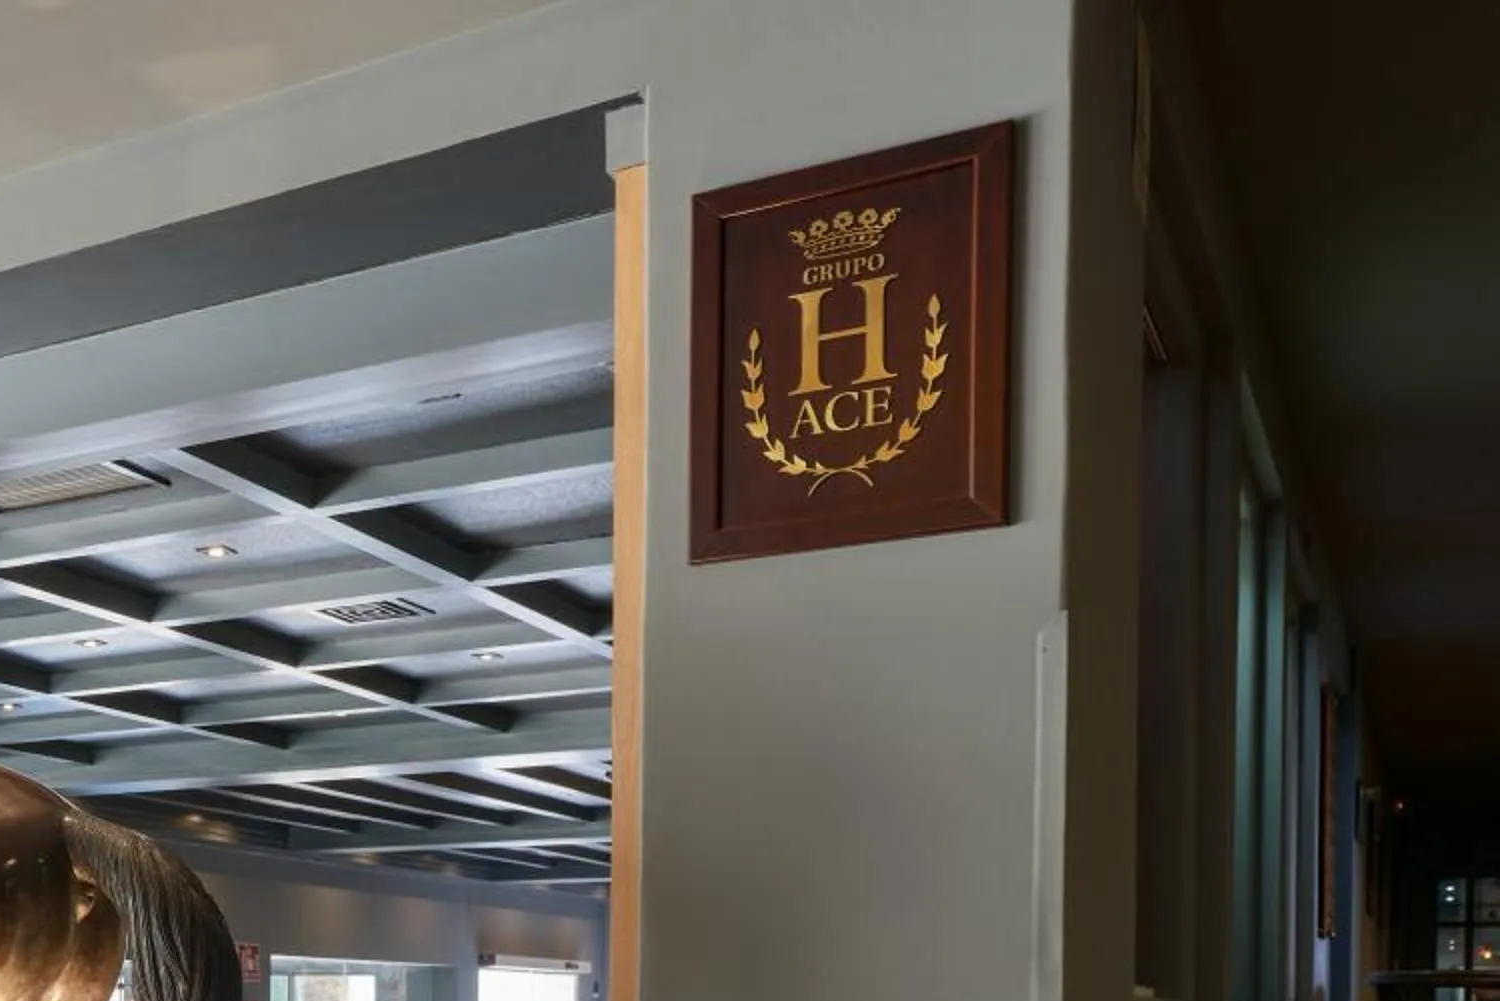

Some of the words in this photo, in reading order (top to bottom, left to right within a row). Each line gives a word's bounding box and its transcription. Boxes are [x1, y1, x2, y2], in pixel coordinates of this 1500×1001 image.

[803, 252, 885, 286] GRUPO
[788, 273, 899, 397] H
[789, 386, 894, 439] ACE
